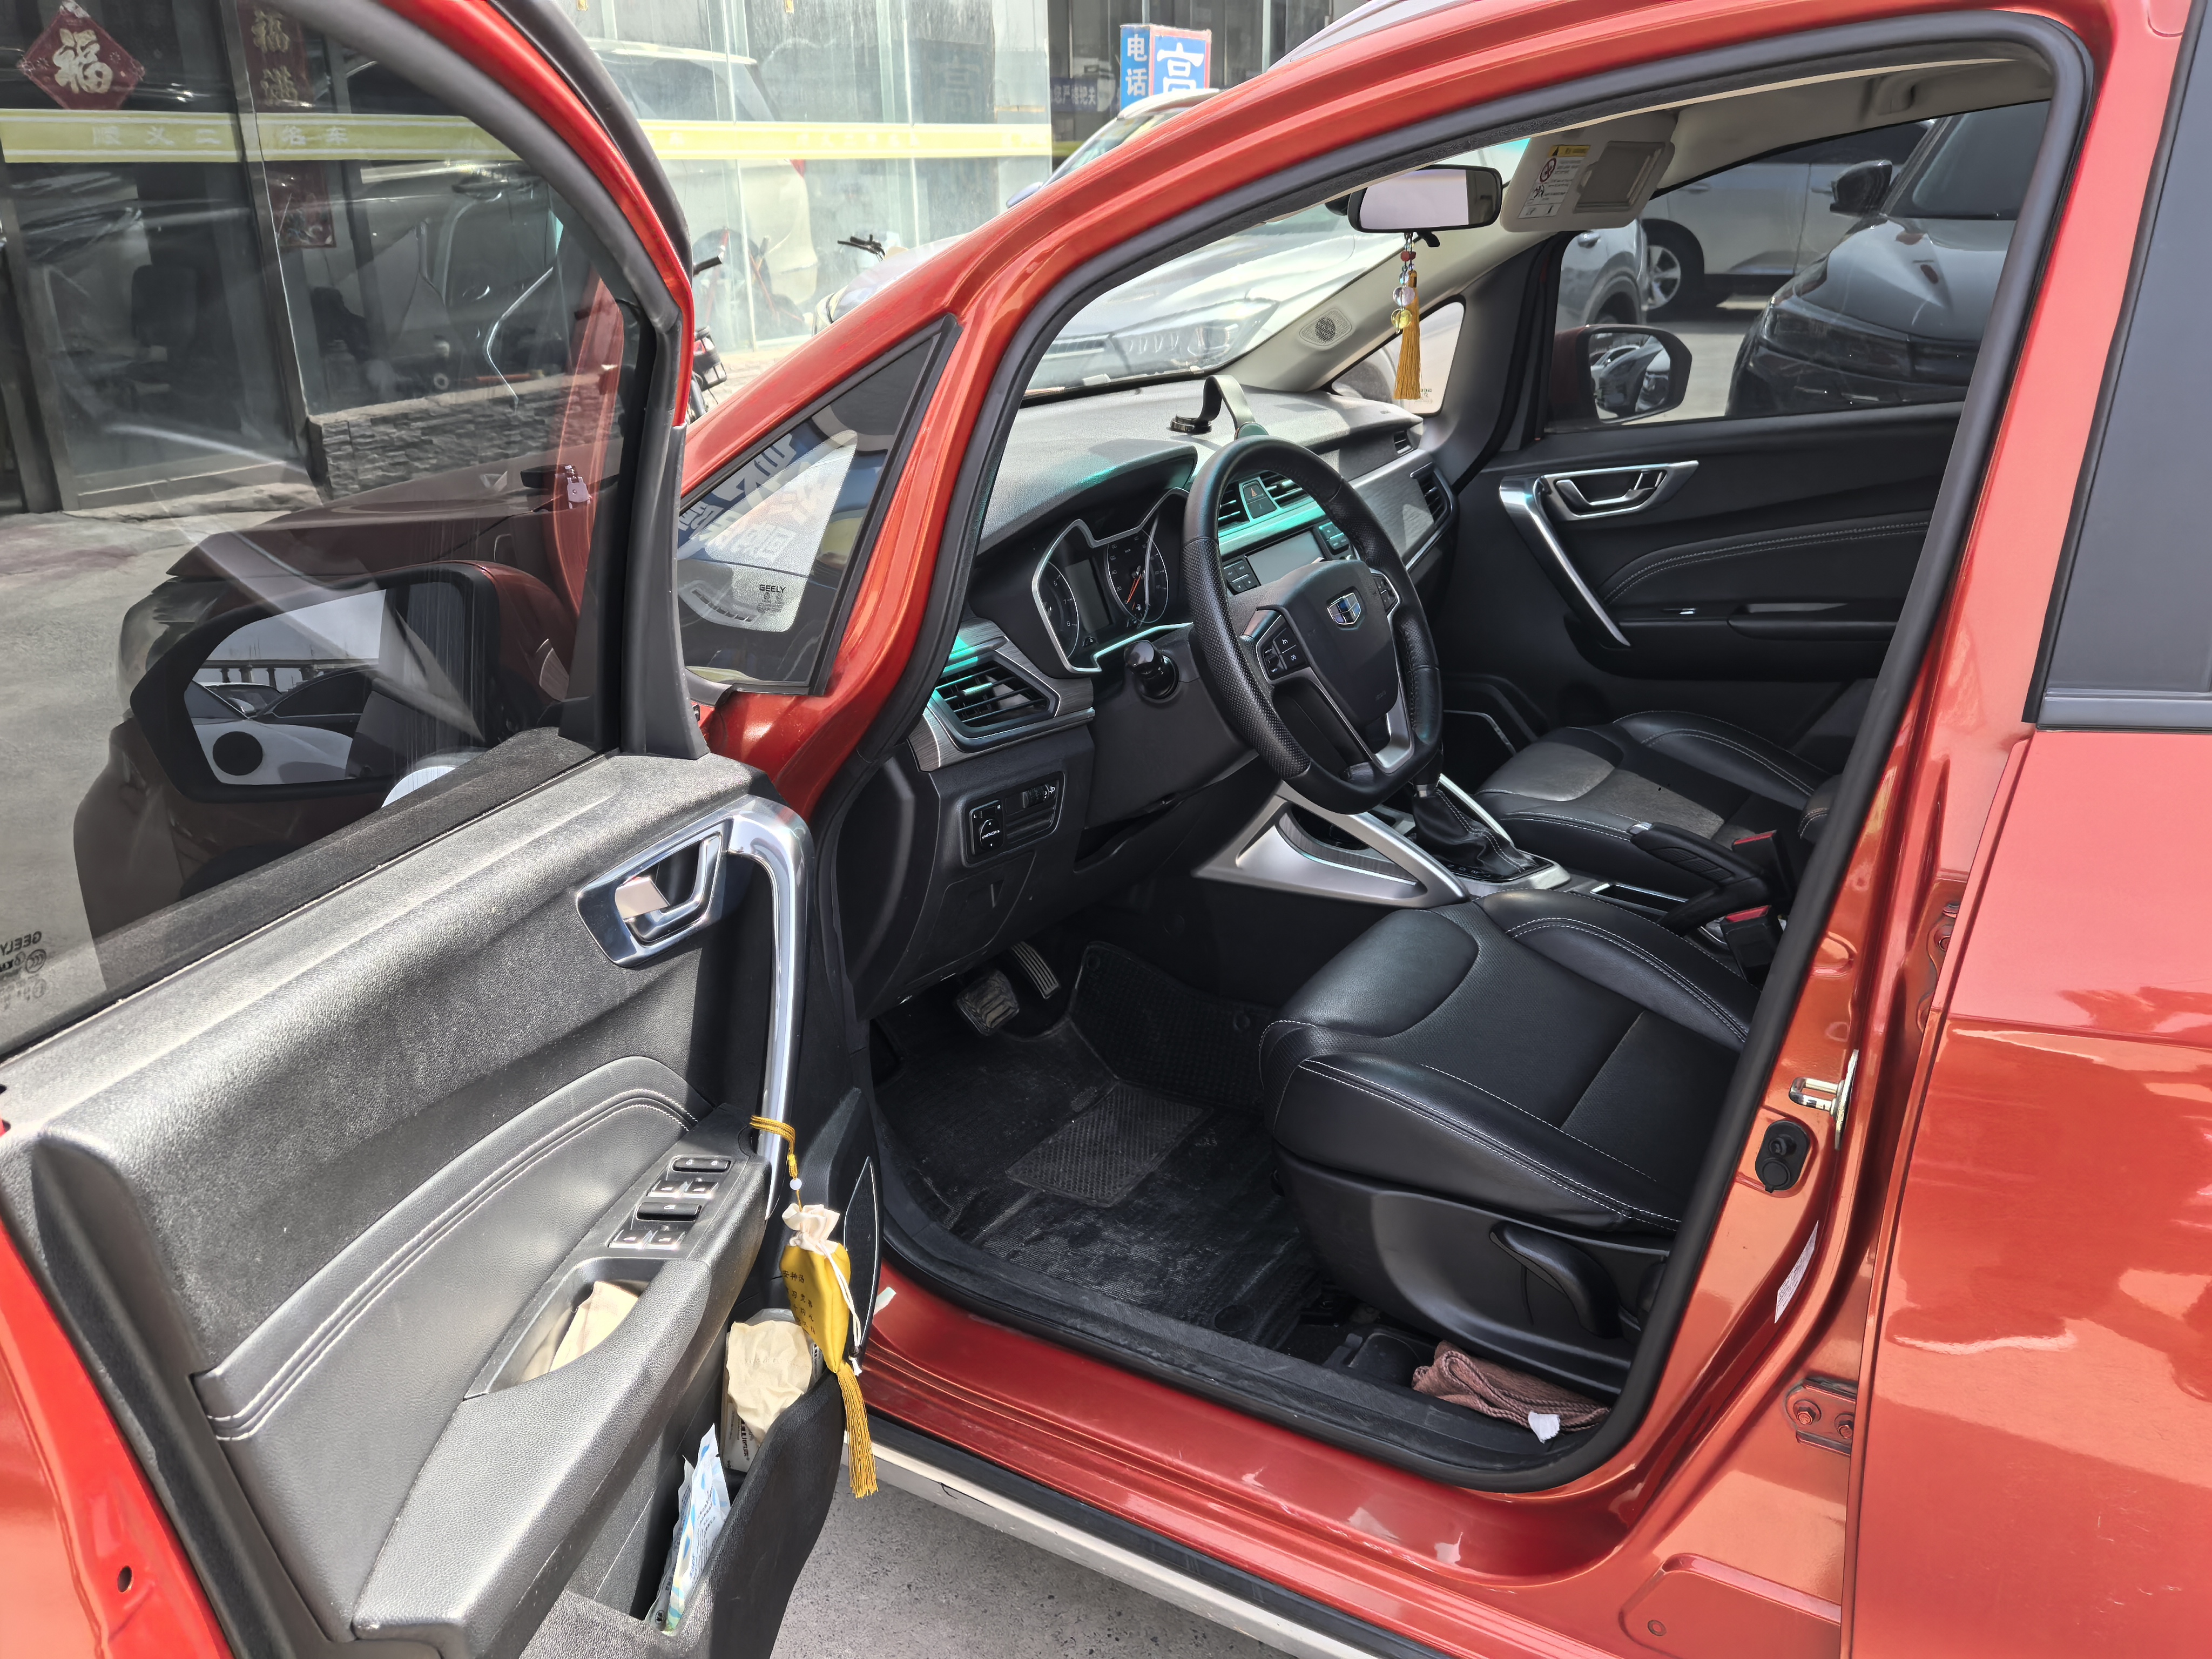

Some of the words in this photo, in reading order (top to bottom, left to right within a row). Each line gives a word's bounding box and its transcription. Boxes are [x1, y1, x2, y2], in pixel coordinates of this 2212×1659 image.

[52, 28, 112, 94] 福
[1125, 34, 1148, 96] 电话
[1157, 42, 1204, 93] 高
[759, 584, 786, 593] GEELY
